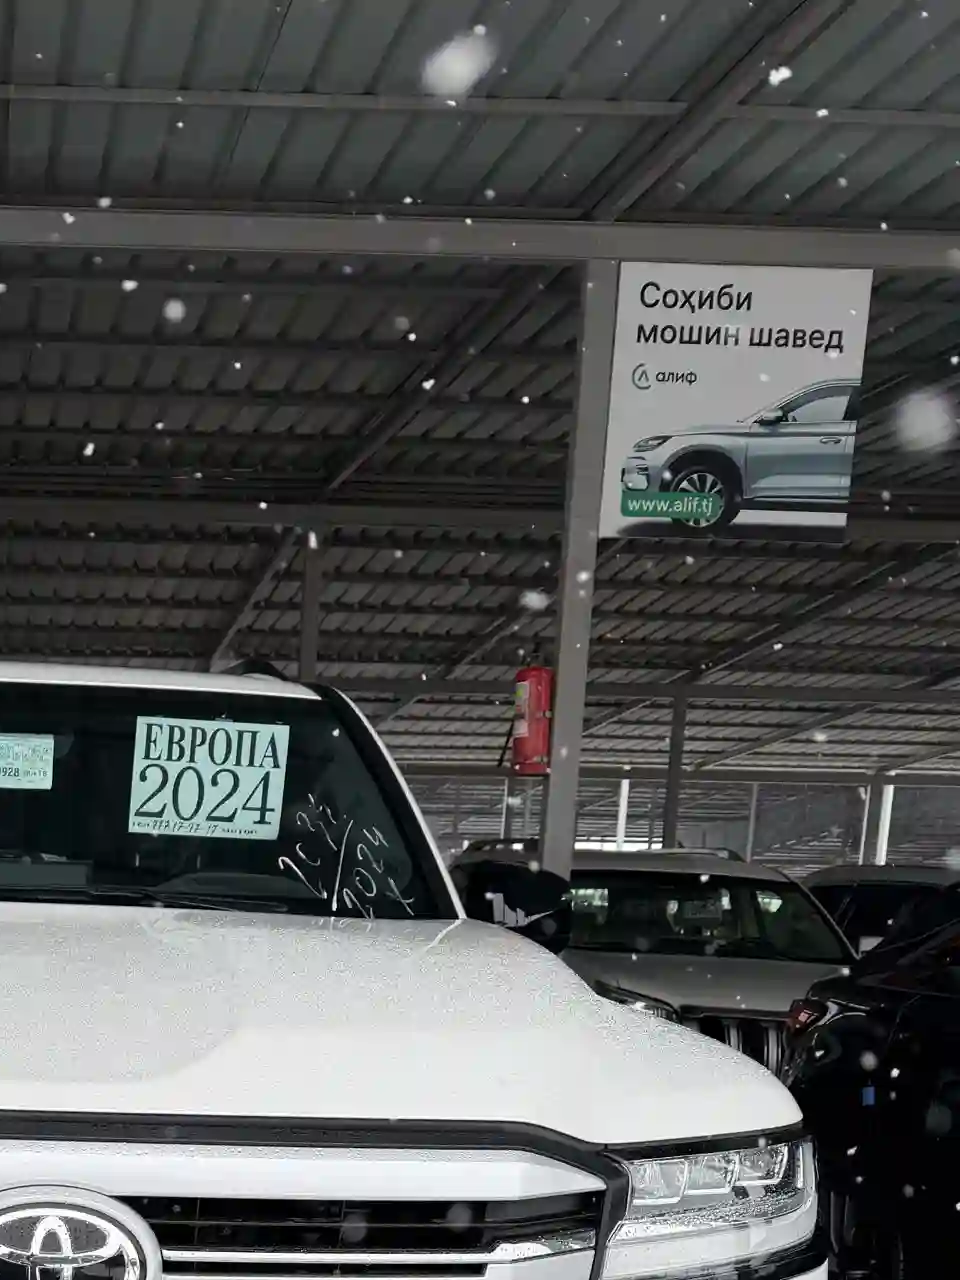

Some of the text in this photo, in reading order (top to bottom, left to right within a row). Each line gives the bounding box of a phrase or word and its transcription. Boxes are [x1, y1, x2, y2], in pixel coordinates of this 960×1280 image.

[640, 281, 753, 313] Соҳиби
[636, 324, 844, 353] мошин шавед
[655, 368, 698, 386] алиф
[627, 496, 714, 516] www.alif.tj
[141, 722, 282, 769] ЕВРОПА
[133, 763, 276, 825] 2024
